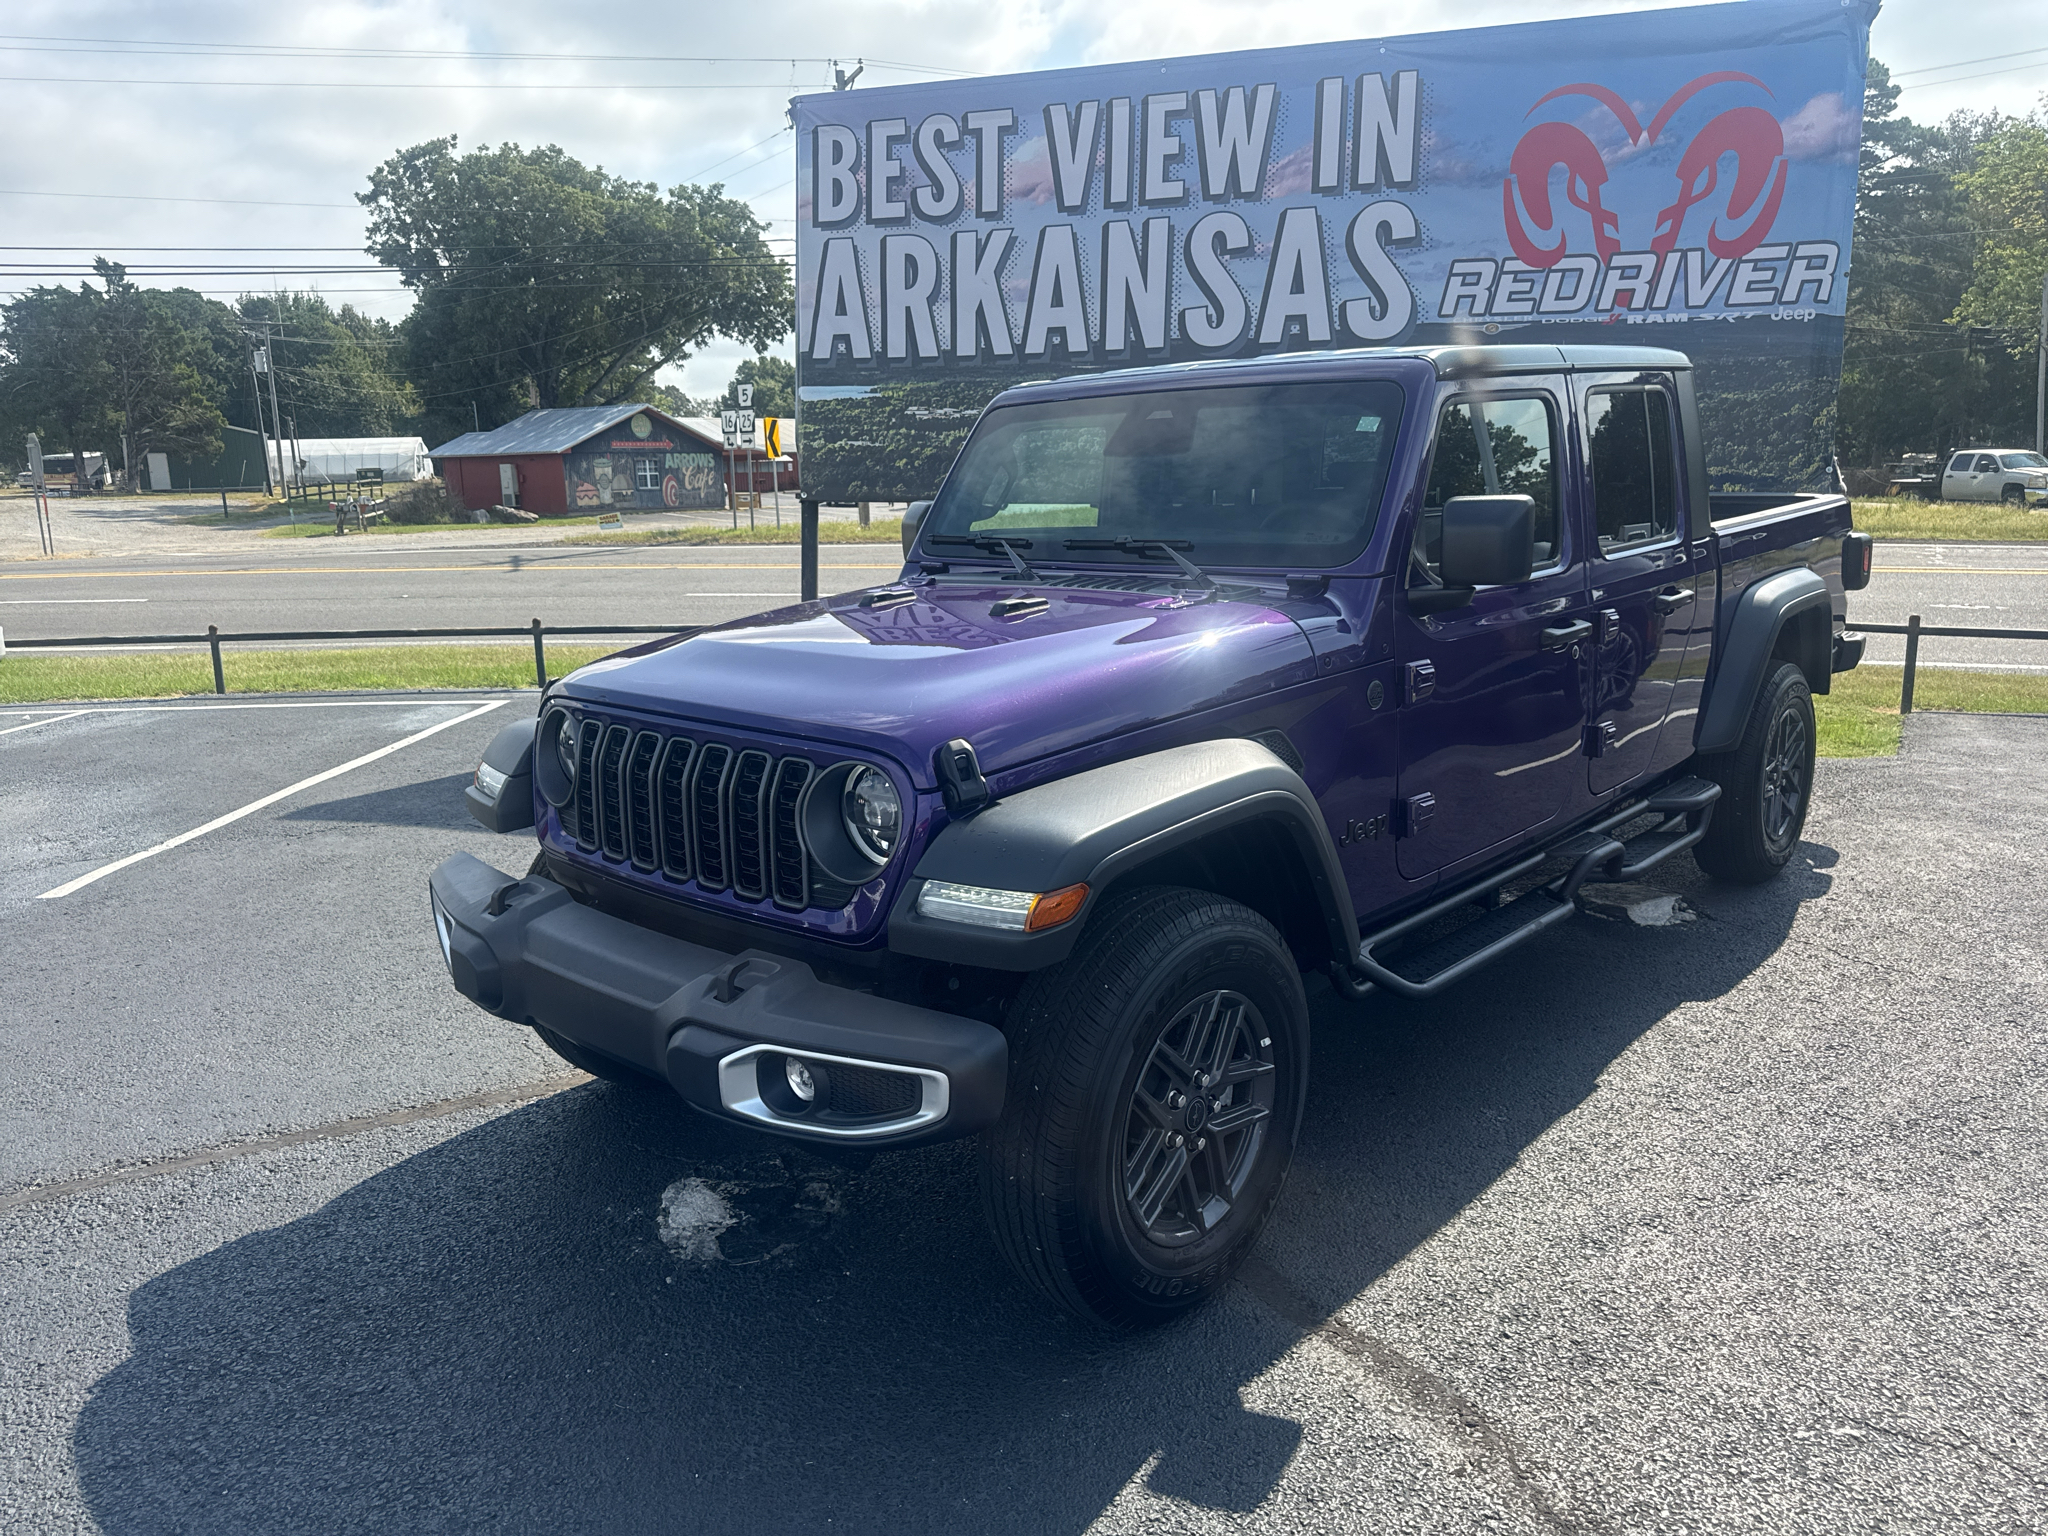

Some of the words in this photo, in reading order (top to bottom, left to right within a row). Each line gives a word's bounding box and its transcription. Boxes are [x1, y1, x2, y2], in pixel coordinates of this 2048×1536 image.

[813, 107, 1014, 228] BEST
[1044, 82, 1277, 214] VIEW
[1315, 69, 1419, 194] IN
[810, 201, 1421, 360] ARKANSAS
[1438, 240, 1841, 318] REDRIVER
[1452, 315, 1534, 323] CHRYSLER
[1626, 312, 1689, 324] RAM
[1693, 310, 1763, 323] SRT
[1770, 306, 1816, 322] Jeep
[741, 388, 749, 403] 5
[724, 415, 734, 428] 16
[741, 414, 752, 428] 25
[665, 453, 715, 468] ARROWS
[1339, 813, 1387, 848] Jeep
